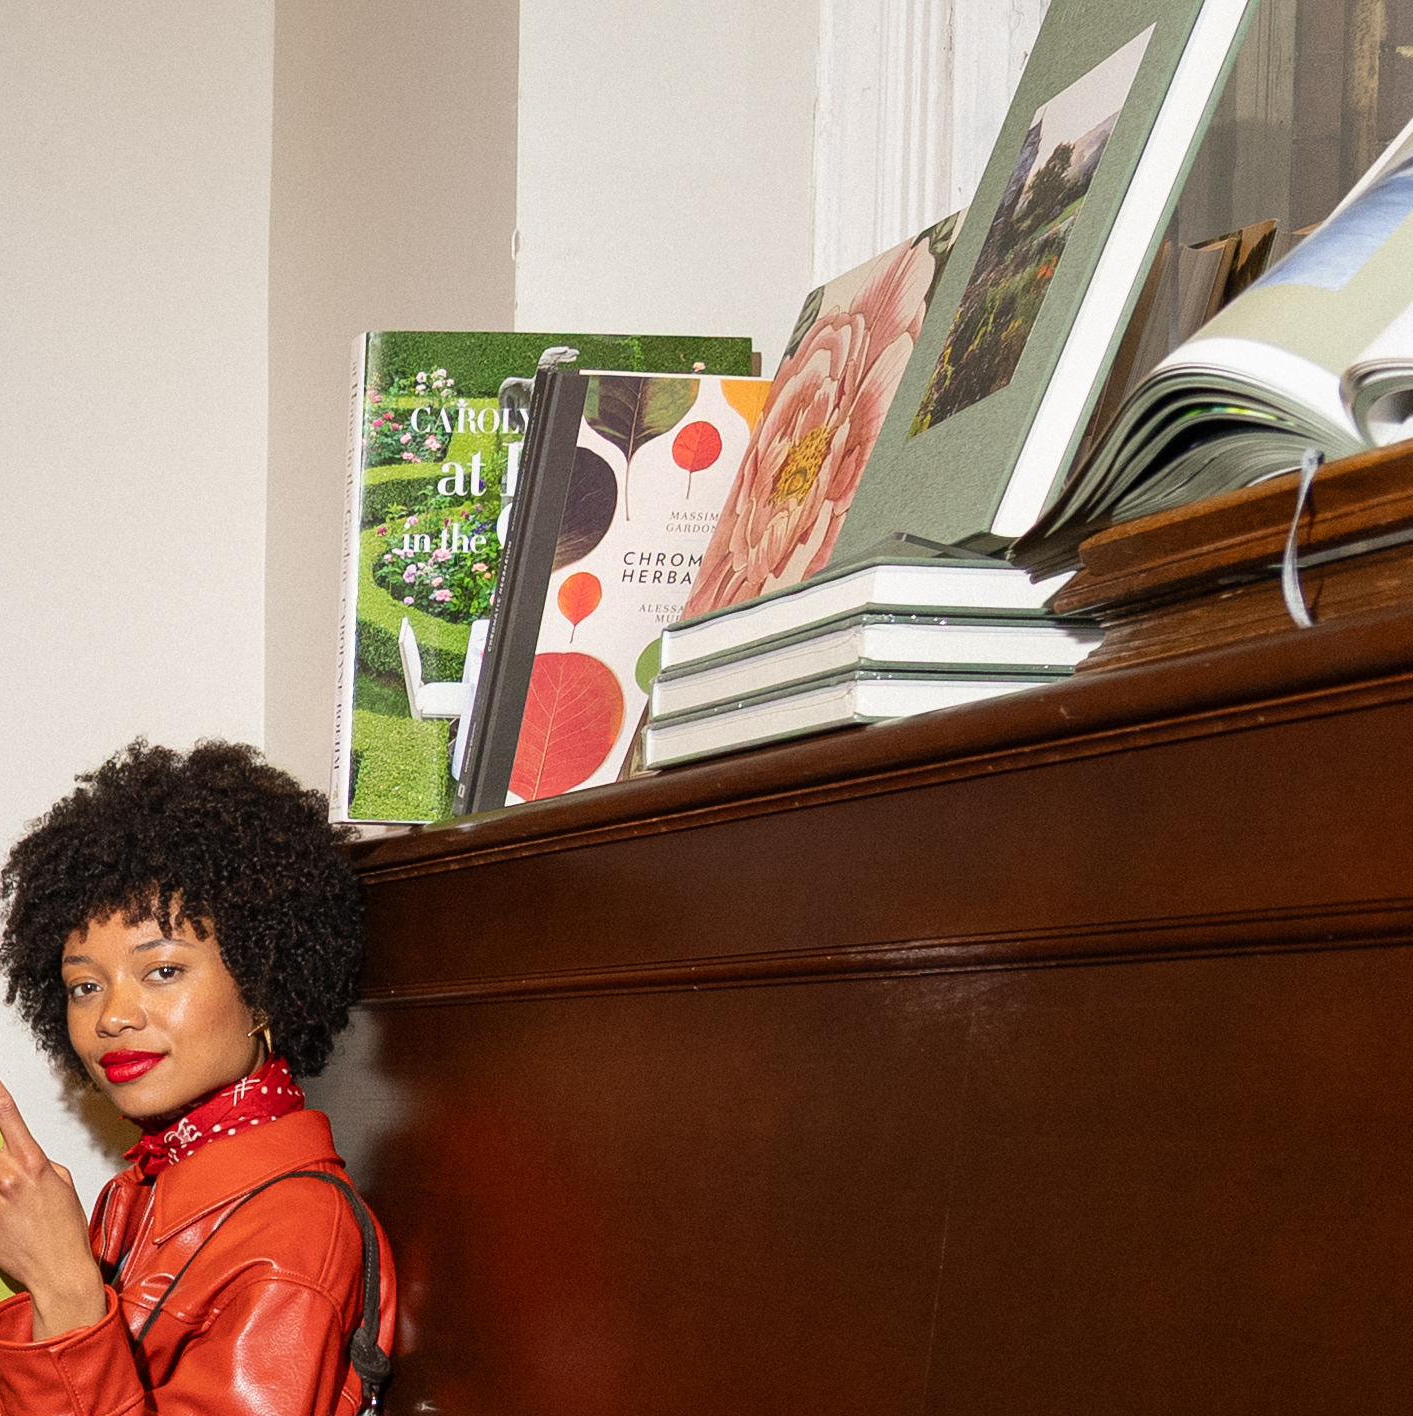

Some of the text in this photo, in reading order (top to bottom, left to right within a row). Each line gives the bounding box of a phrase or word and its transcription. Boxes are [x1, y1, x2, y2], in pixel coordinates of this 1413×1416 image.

[410, 407, 530, 434] CAROLY
[437, 455, 484, 497] at
[402, 523, 487, 554] in the
[623, 551, 703, 569] CHROM
[622, 569, 693, 585] HERBA
